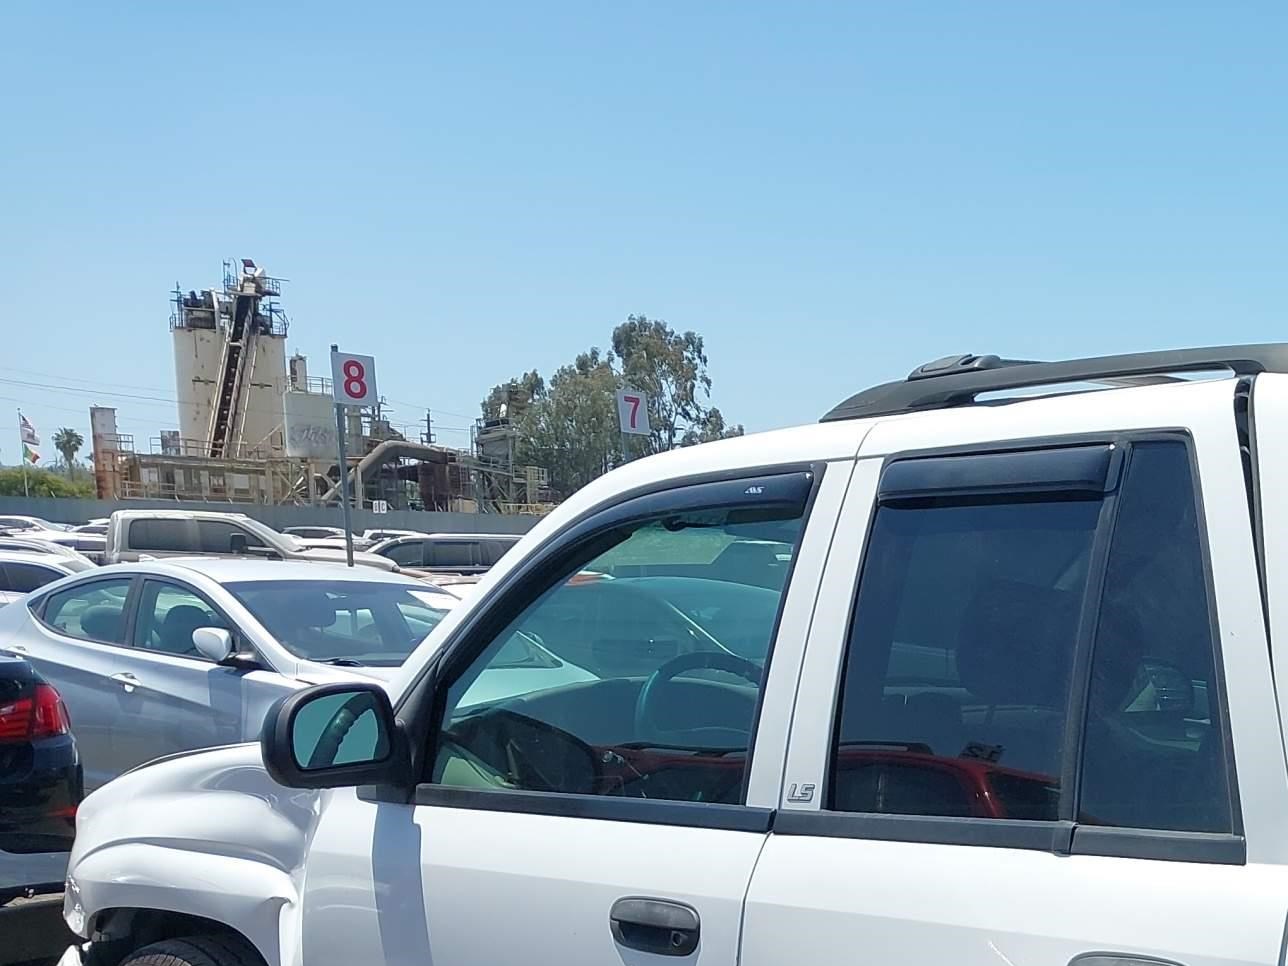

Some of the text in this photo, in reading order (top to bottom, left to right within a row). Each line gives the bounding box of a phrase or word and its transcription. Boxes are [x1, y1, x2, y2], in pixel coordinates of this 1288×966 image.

[343, 359, 368, 400] 8
[623, 395, 641, 429] 7
[787, 783, 815, 803] LS
